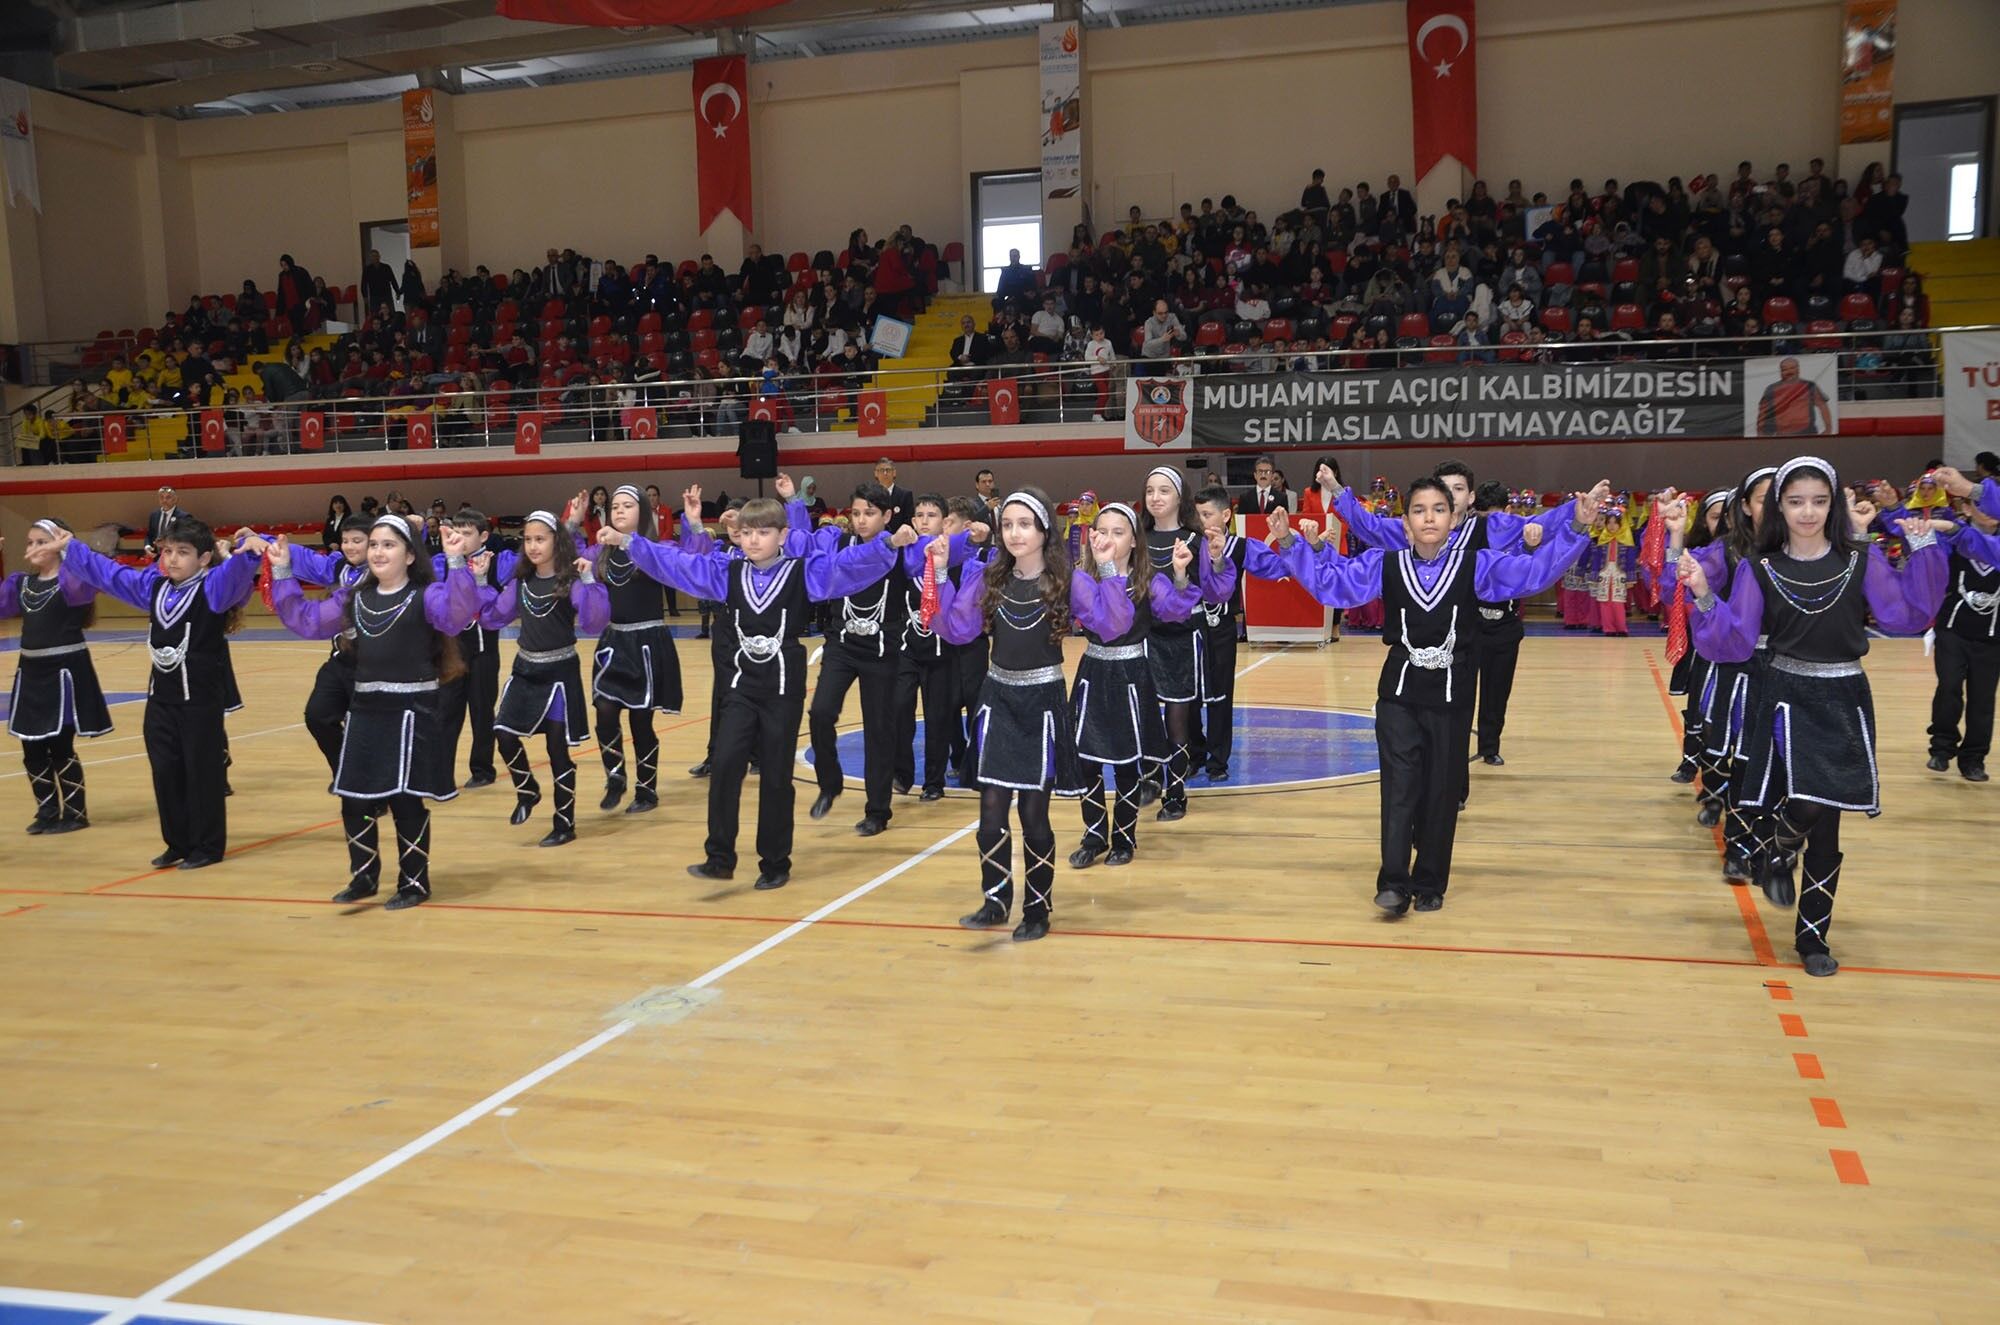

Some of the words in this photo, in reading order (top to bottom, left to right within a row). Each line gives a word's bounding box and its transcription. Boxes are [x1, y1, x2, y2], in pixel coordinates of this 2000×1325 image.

[1203, 379, 1380, 410] MUHAMMET
[1387, 376, 1468, 407] AÇICI
[1479, 365, 1733, 401] KALBİMİZDESİN
[1243, 411, 1313, 443] SENİ
[1321, 415, 1402, 442] ASLA
[1410, 402, 1686, 439] UNUTMAYACAĞIZ
